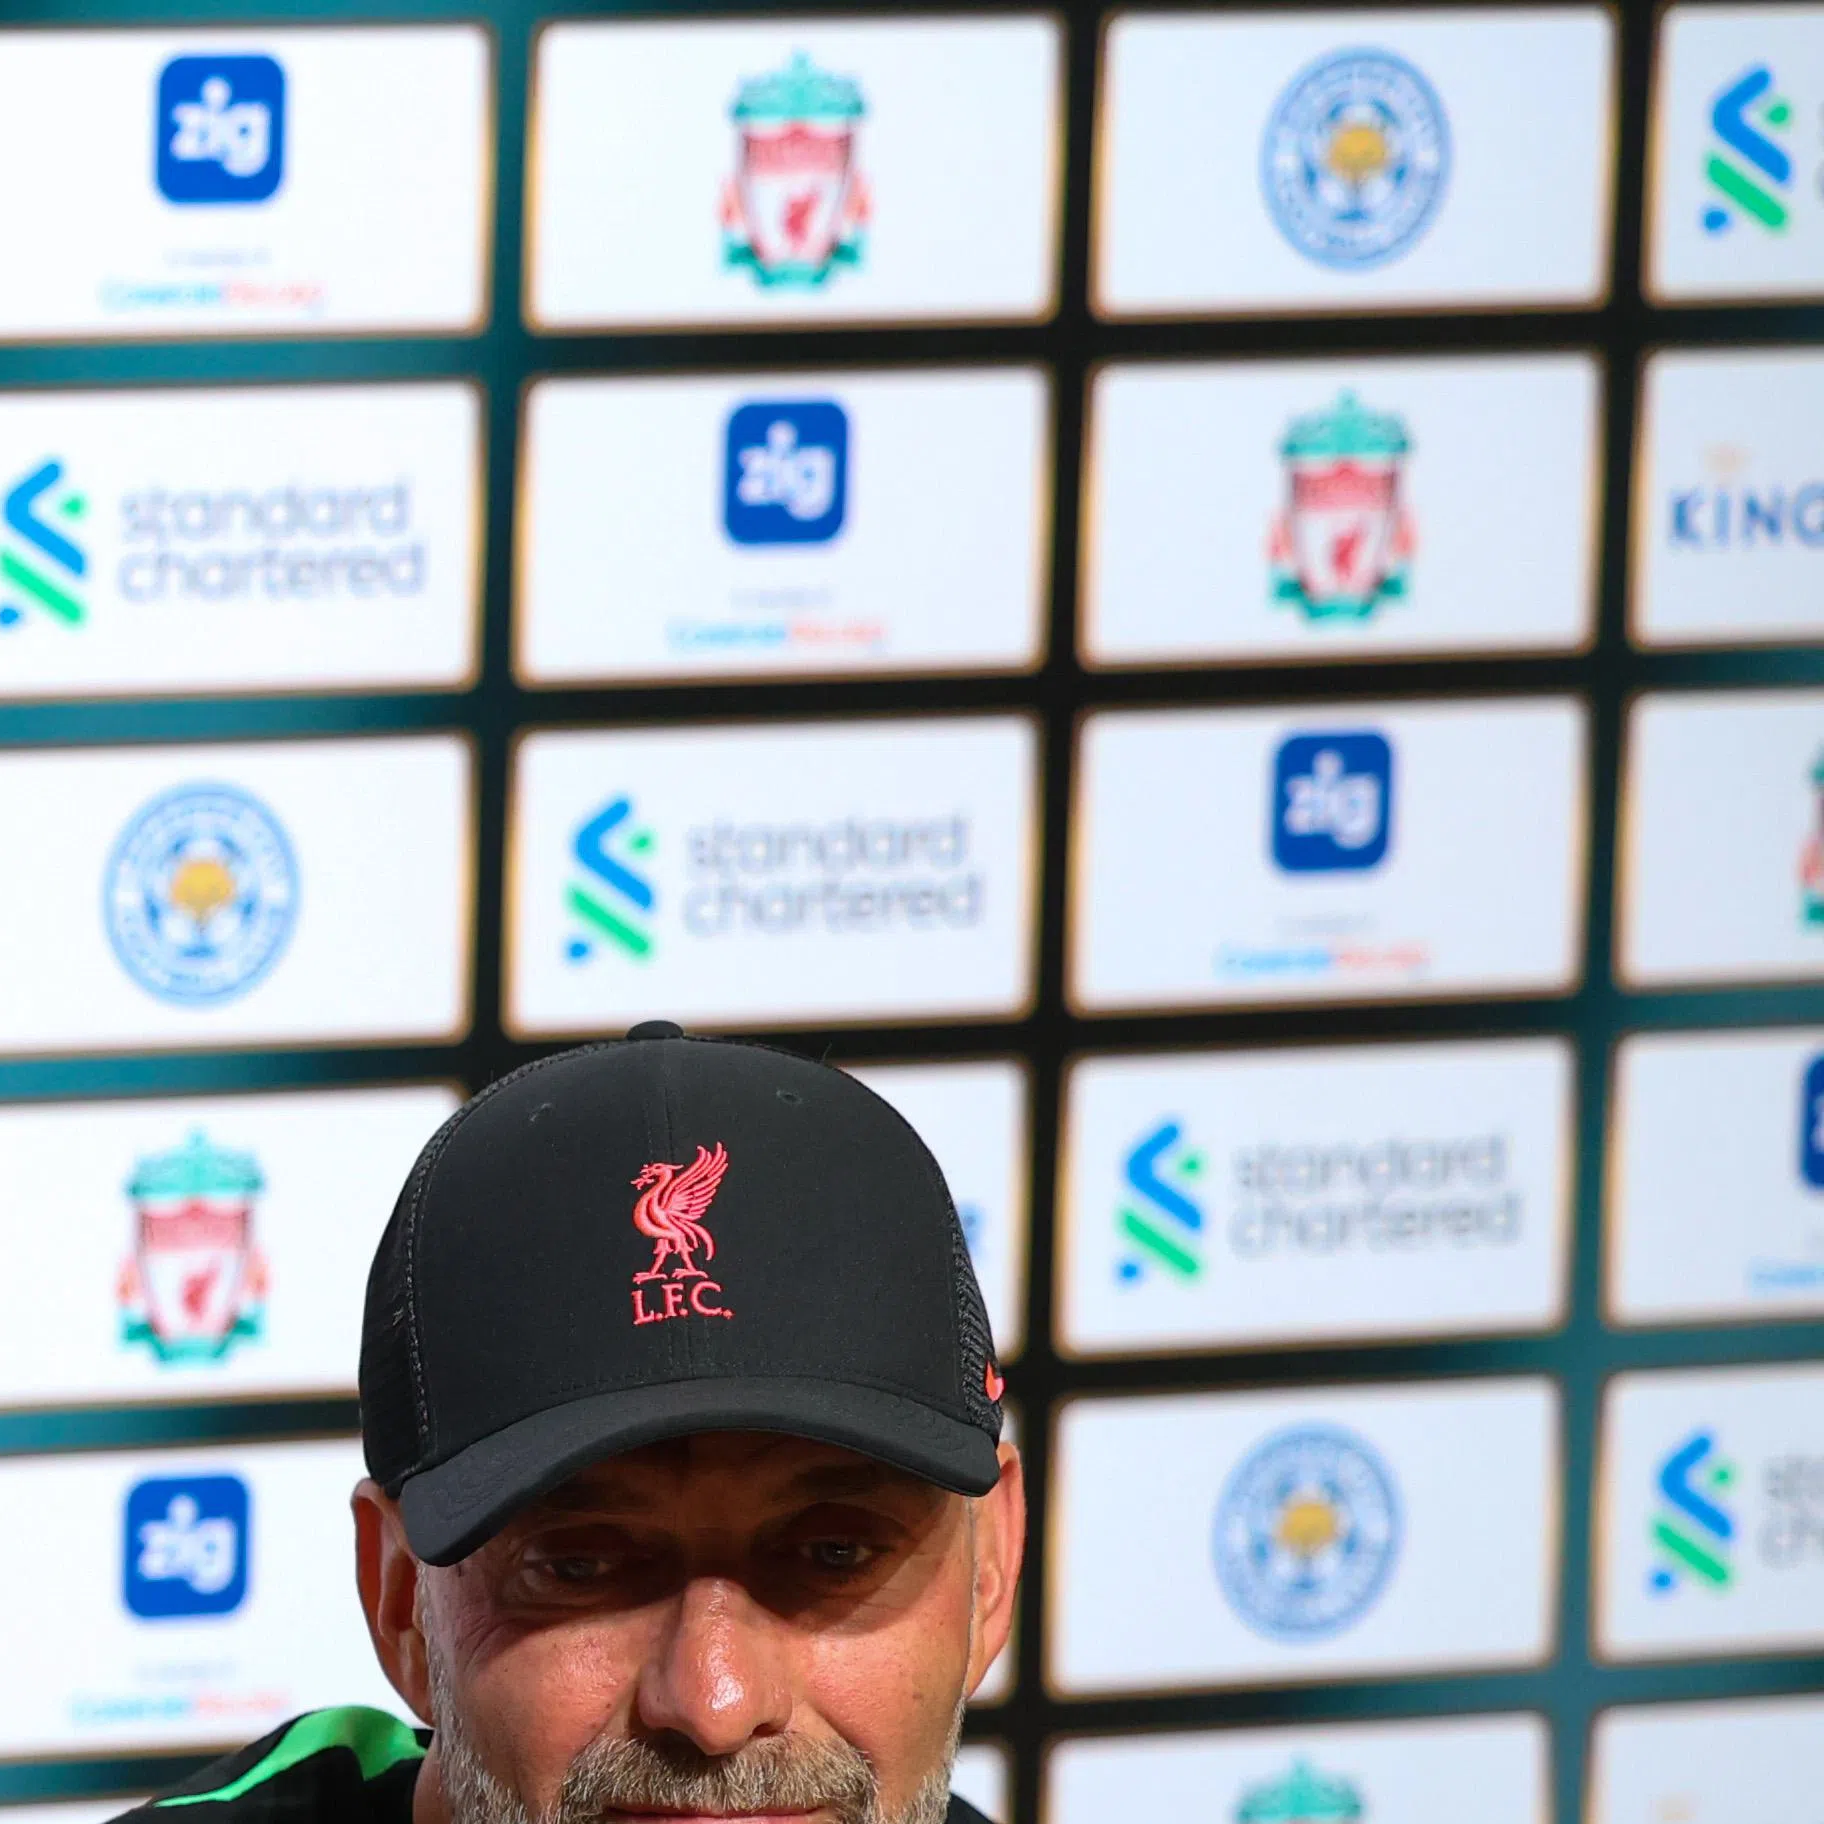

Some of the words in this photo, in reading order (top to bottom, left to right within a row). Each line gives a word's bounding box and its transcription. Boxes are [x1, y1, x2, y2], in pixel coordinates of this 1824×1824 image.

[170, 78, 272, 176] zig
[117, 478, 410, 541] standard
[117, 538, 429, 600] chartered
[631, 1281, 734, 1325] L.F.C.
